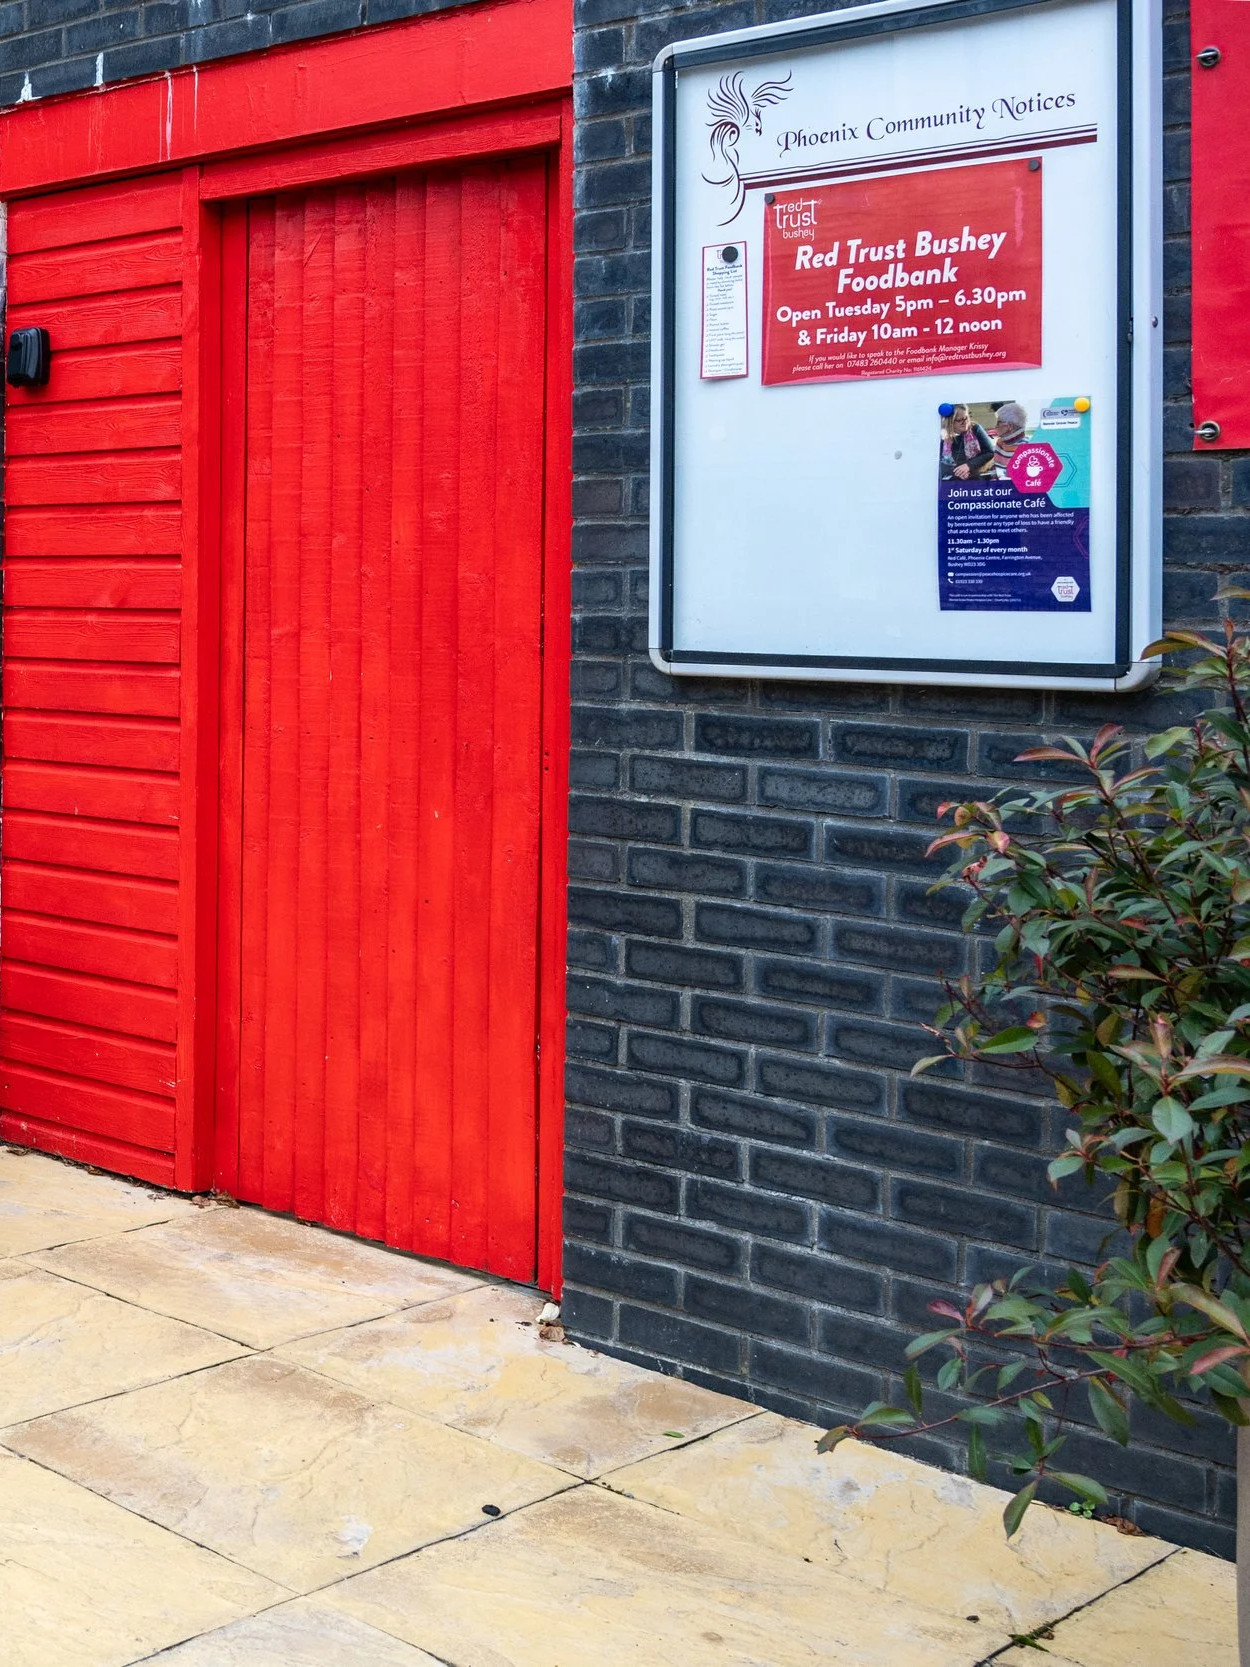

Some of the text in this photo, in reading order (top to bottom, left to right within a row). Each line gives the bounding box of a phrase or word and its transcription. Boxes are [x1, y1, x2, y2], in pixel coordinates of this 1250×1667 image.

[776, 92, 1076, 158] Phoenix Community Notices
[773, 199, 818, 229] trust
[782, 197, 803, 213] red
[782, 227, 815, 241] bushey
[794, 225, 1007, 270] Red Trust Bushey
[837, 257, 959, 293] Foodbank
[776, 305, 821, 327] Open
[825, 298, 890, 319] Tuesday
[895, 295, 934, 316] 5pm
[954, 286, 1026, 309] 6.30pm
[797, 331, 811, 346] &
[816, 327, 868, 348] Friday
[871, 322, 918, 340] 10am
[935, 318, 954, 335] 12
[959, 318, 1003, 333] noon
[792, 364, 812, 374] please
[812, 363, 824, 371] call
[846, 360, 869, 368] 07483
[869, 357, 897, 366] 260440
[906, 355, 925, 363] email
[925, 351, 1007, 364] info@redtrustbushey.org
[809, 355, 815, 364] If
[815, 356, 827, 364] you
[828, 353, 846, 361] would
[866, 350, 884, 360] speak
[894, 348, 905, 356] the
[906, 346, 937, 355] Foodbank
[938, 343, 968, 354] Manager
[969, 342, 989, 352] Krissy
[1012, 447, 1055, 470] Compassionate
[947, 488, 1012, 498] Join us at our
[1025, 478, 1042, 487] Café
[947, 497, 1046, 511] Compassionate Café
